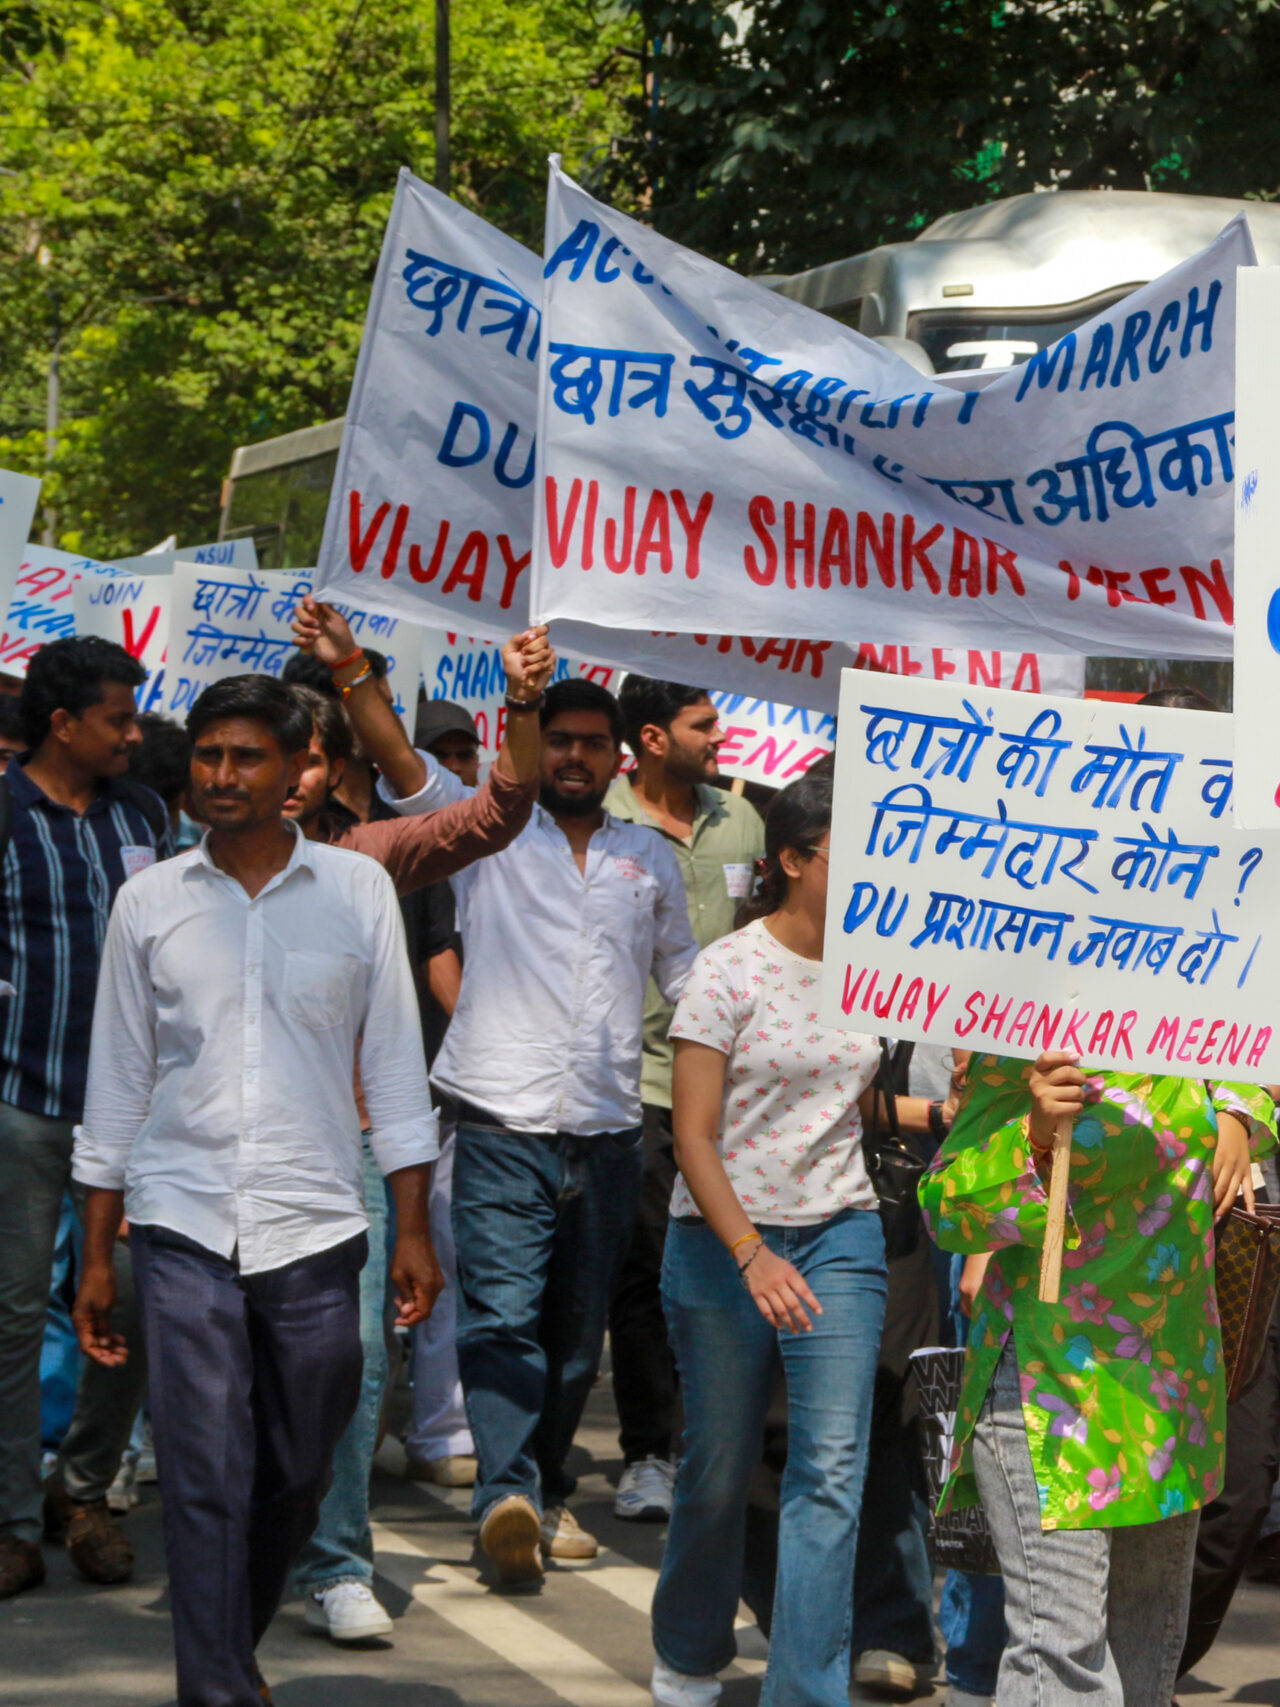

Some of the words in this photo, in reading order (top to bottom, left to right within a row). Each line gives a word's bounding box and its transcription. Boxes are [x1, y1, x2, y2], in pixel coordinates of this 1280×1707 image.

[1014, 279, 1223, 404] MARCH
[437, 401, 537, 489] DU
[548, 342, 675, 425] छात्र
[1027, 410, 1235, 526] अधिका
[348, 490, 531, 609] VIJAY
[545, 476, 714, 580] VIJAY
[743, 495, 1026, 599] SHANKAR
[89, 580, 144, 605] JOIN
[192, 573, 270, 622] छात्रों
[182, 623, 298, 676] जिम्मेद
[860, 698, 993, 782] छात्रों
[996, 708, 1072, 796] की
[1071, 723, 1184, 813] मौत
[865, 783, 1099, 895] जिम्मेदार
[1111, 821, 1219, 900] कौन
[842, 881, 909, 937] DU
[909, 890, 1075, 961] प्रशासन
[1069, 914, 1184, 976] जवाब
[840, 963, 950, 1033] VIJAY
[954, 990, 1138, 1060] SHANKAR
[1146, 1015, 1273, 1067] MEENA
